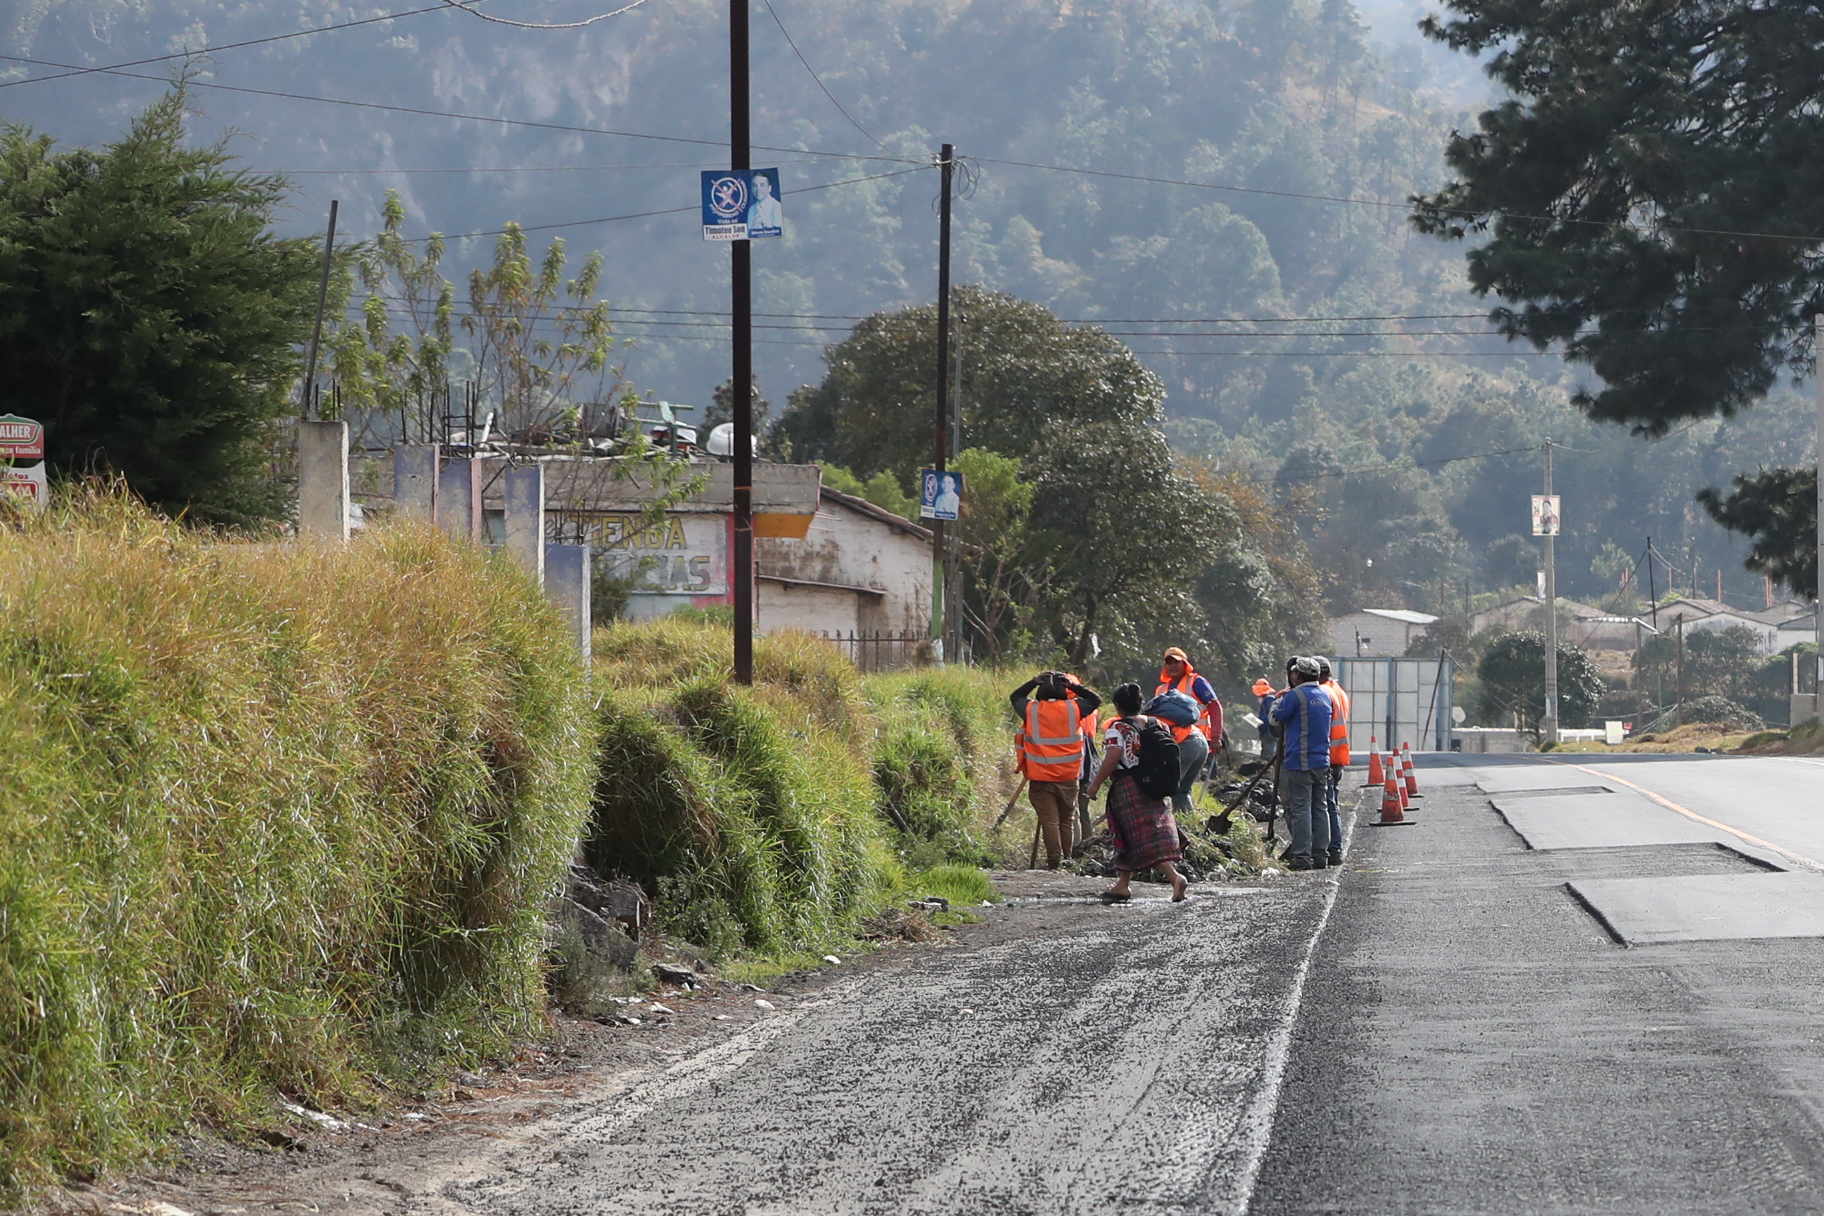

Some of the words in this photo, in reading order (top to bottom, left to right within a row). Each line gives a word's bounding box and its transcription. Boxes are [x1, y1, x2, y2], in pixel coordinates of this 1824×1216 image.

[705, 226, 732, 235] Timoteo
[733, 225, 745, 234] Son
[15, 446, 41, 454] familia
